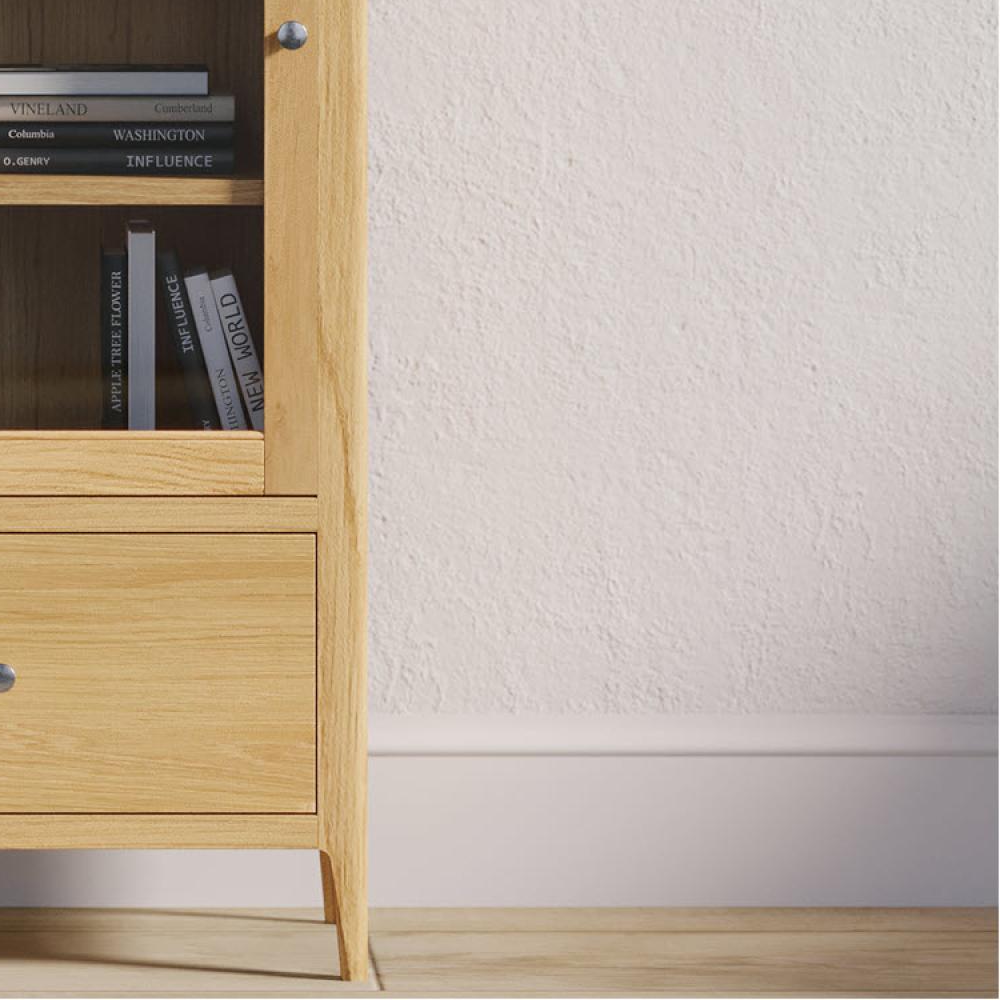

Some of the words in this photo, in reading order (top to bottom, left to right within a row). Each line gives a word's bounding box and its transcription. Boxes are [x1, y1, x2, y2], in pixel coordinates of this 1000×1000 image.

[10, 103, 88, 116] VINELAND
[154, 103, 213, 114] Cumberland
[7, 129, 55, 139] Columbia
[113, 129, 205, 141] WASHINGTON
[3, 156, 50, 167] O.GENRY
[126, 155, 213, 168] INFLUENCE
[111, 271, 122, 326] FLOWER
[166, 274, 194, 354] INFLUENCE
[111, 327, 122, 367] TREE
[220, 293, 253, 361] WORLD
[111, 368, 122, 412] APPLE
